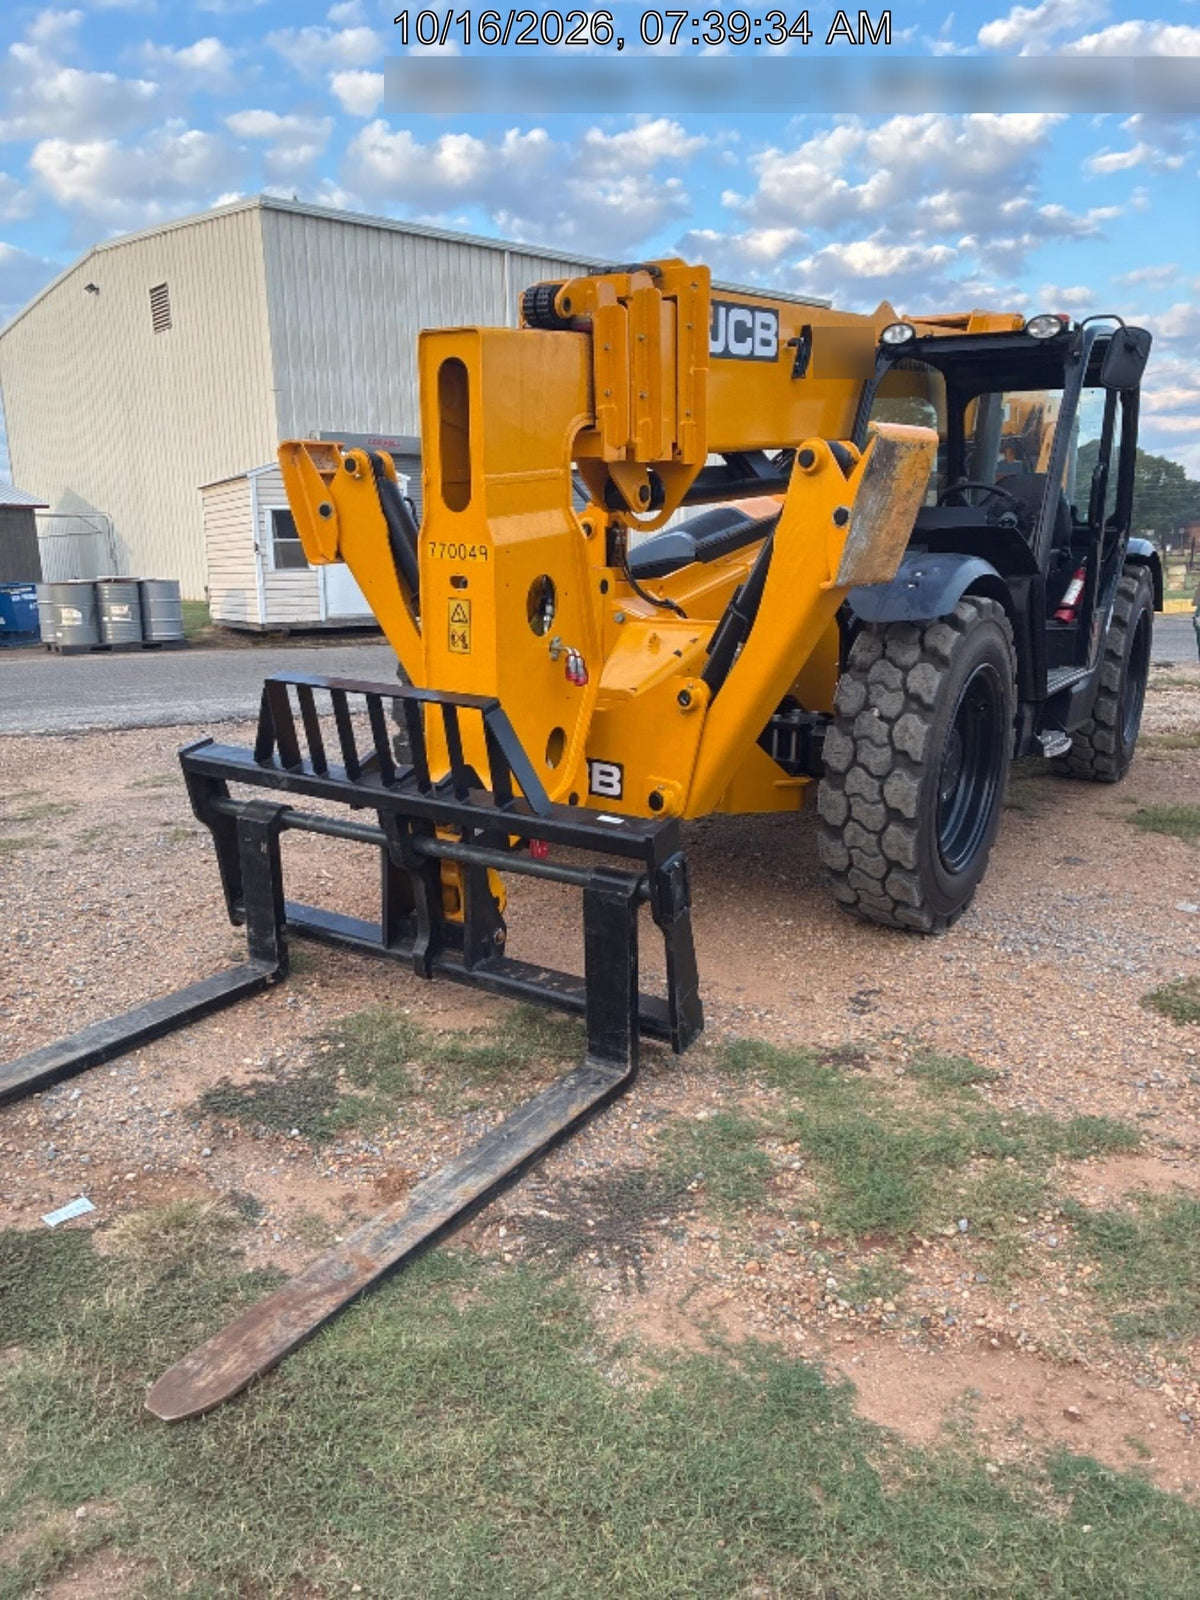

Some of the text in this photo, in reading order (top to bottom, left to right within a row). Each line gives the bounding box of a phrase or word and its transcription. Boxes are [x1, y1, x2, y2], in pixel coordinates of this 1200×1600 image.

[710, 305, 778, 357] JCB
[428, 541, 488, 561] 770049
[590, 761, 622, 796] B
